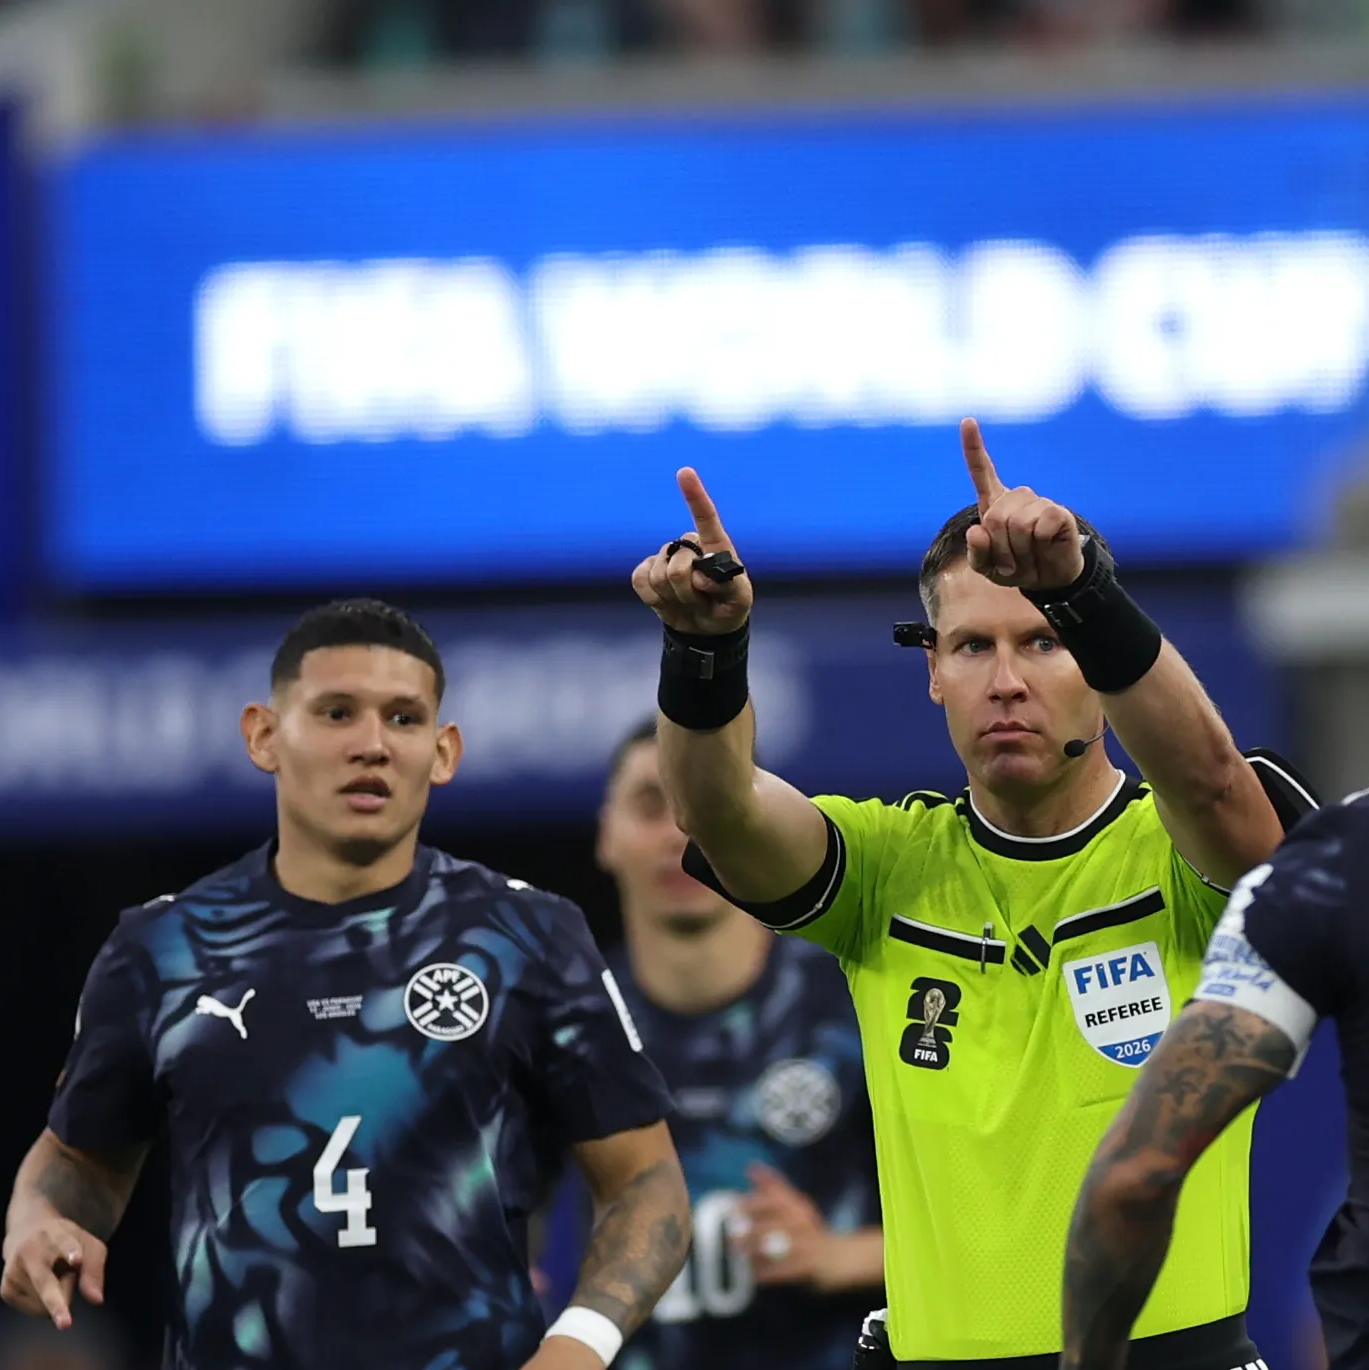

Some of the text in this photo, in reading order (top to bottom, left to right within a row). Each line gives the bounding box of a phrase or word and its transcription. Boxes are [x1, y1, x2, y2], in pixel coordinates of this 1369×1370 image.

[432, 968, 461, 983] APF
[1073, 953, 1155, 995] FIFA
[1085, 997, 1163, 1028] REFEREE
[913, 1048, 938, 1063] FIFA
[1115, 1040, 1151, 1060] 2026
[313, 1115, 378, 1248] 4
